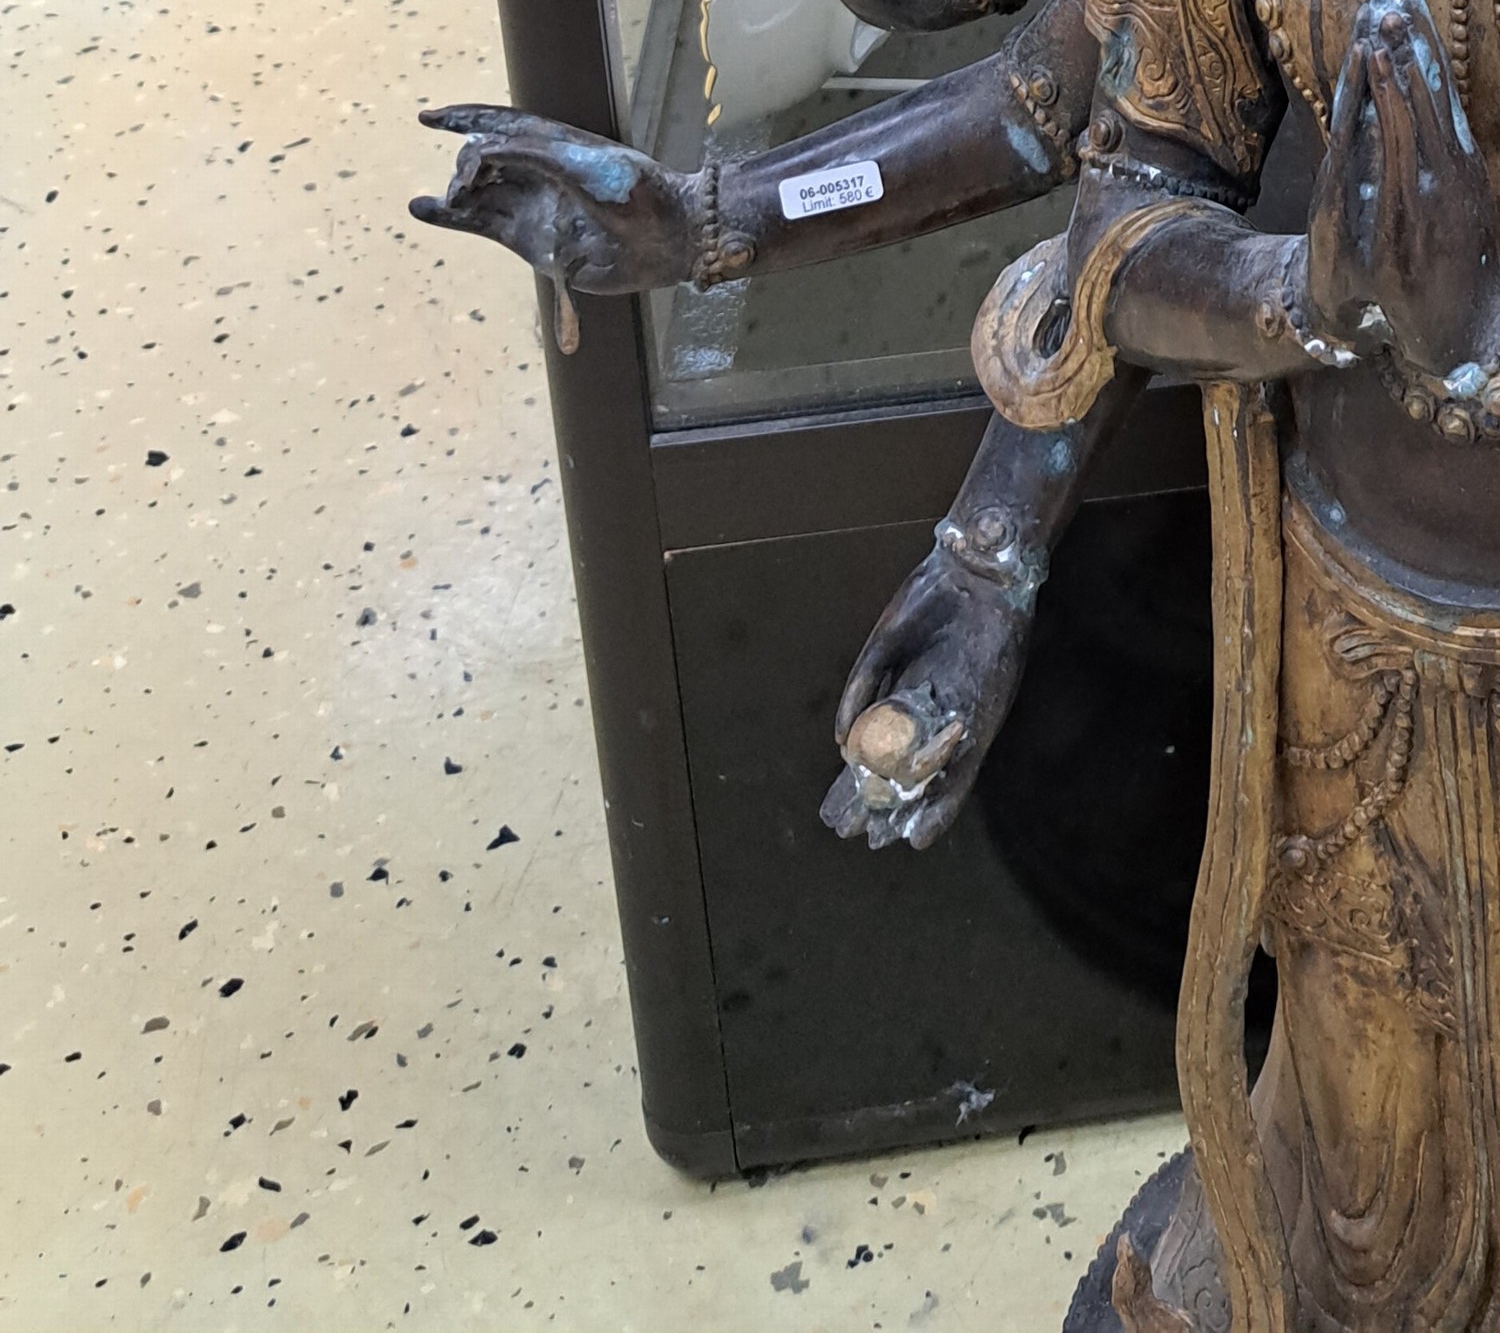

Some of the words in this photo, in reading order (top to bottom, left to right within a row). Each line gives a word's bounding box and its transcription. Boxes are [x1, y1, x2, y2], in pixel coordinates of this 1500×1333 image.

[799, 175, 864, 200] 06-005317
[802, 196, 836, 213] Limit:
[839, 190, 862, 205] 580
[865, 185, 874, 198] €
